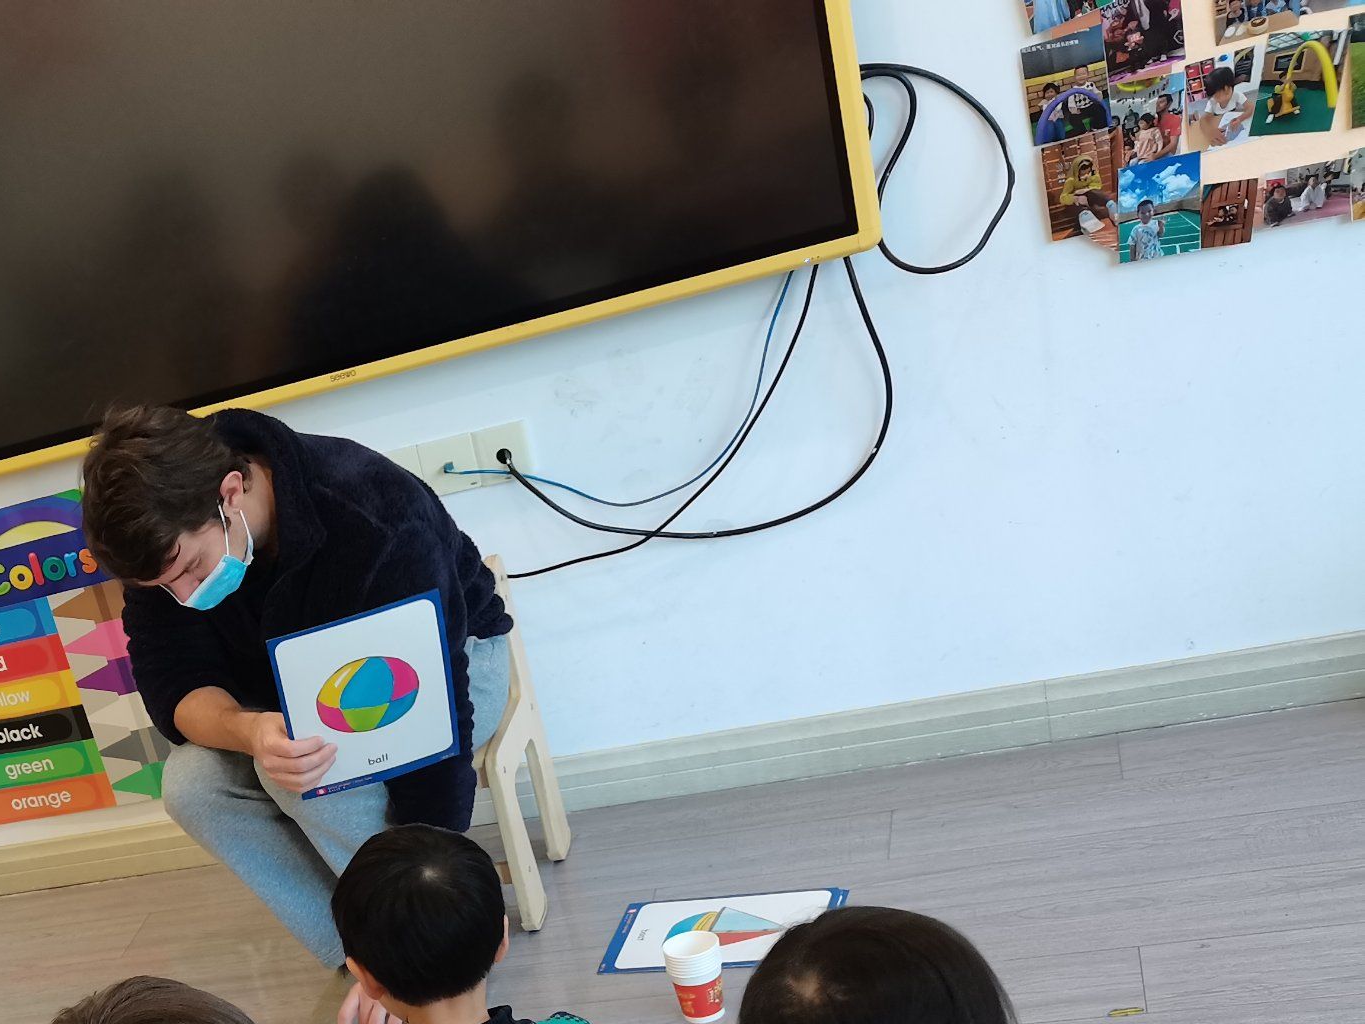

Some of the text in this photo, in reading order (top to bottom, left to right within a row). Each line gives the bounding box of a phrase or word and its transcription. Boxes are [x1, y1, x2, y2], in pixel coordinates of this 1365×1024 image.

[4, 758, 54, 780] green
[367, 753, 389, 765] ball
[11, 790, 71, 810] orange
